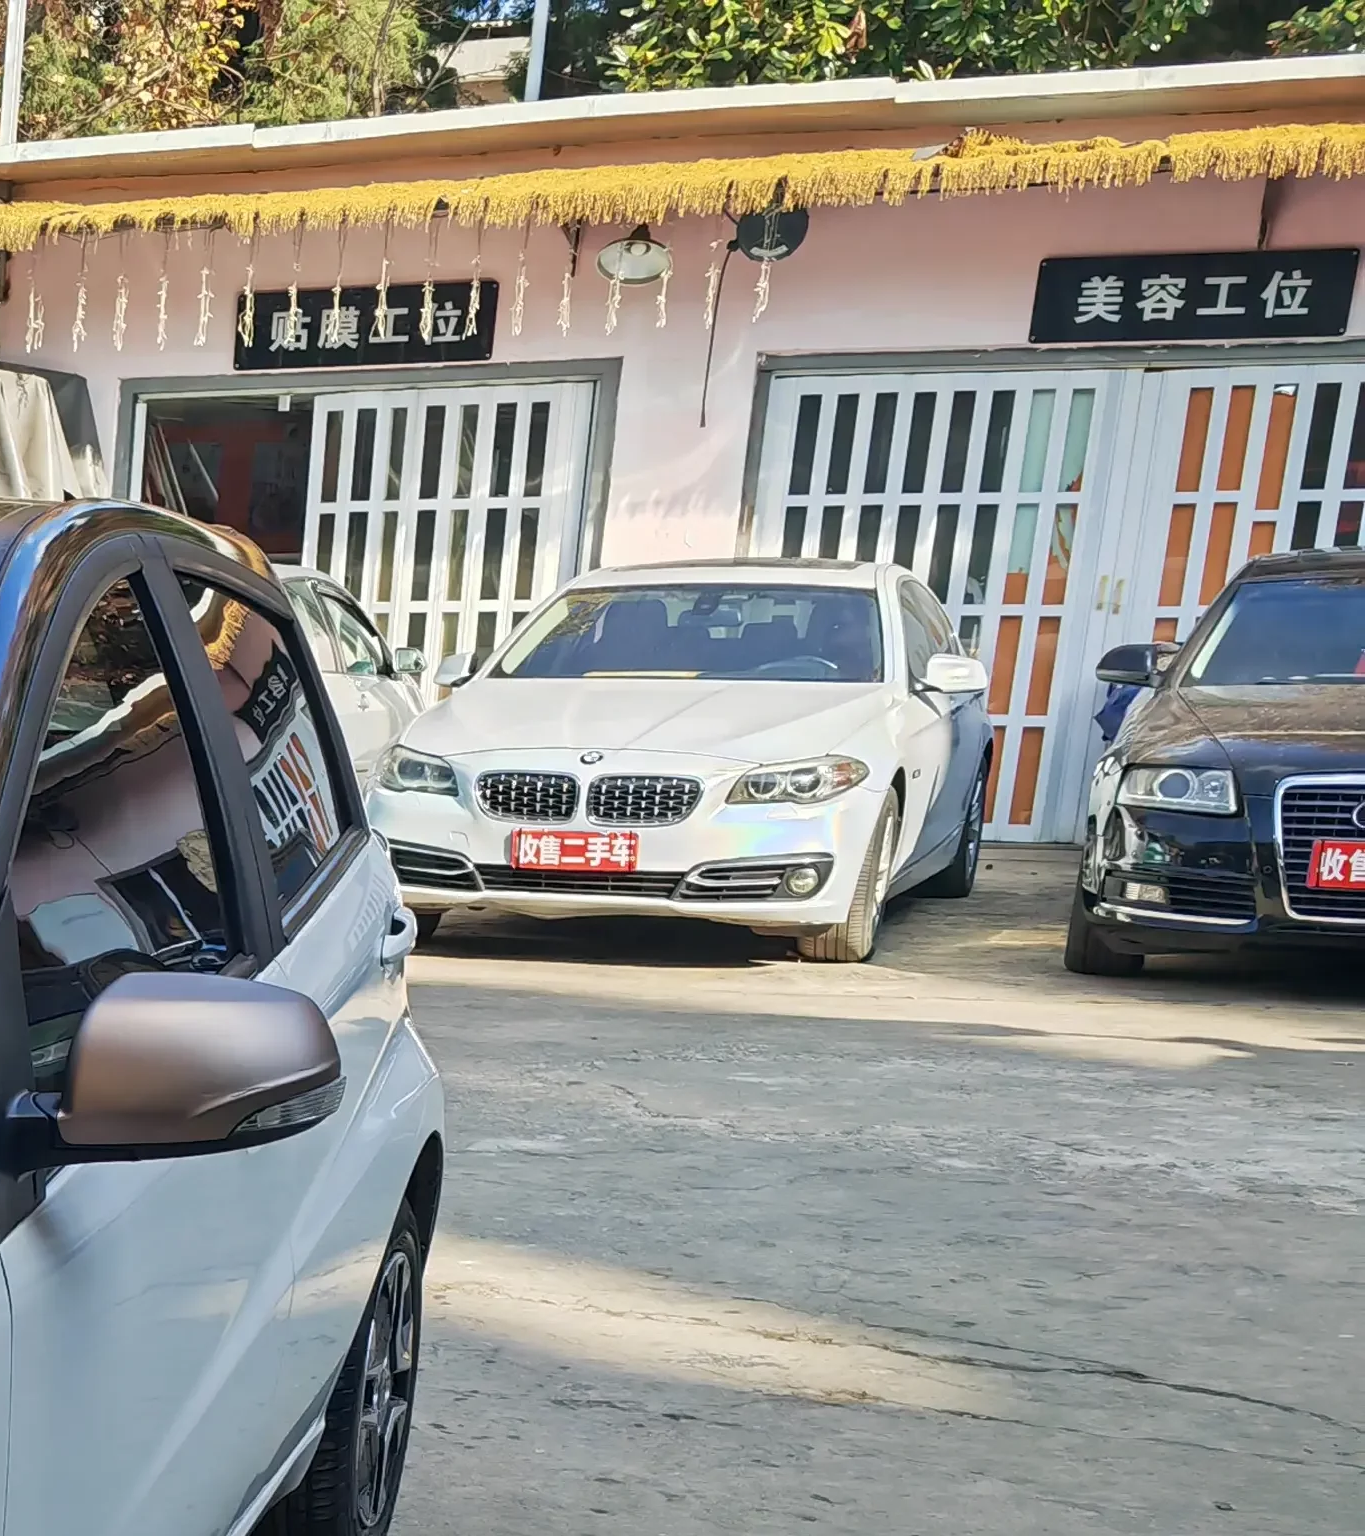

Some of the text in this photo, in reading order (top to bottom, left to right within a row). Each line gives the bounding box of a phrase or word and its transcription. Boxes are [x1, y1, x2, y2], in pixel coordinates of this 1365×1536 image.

[1073, 268, 1313, 325] 美容工位
[268, 301, 463, 352] 贴膜工位
[517, 833, 636, 868] 收售二手车
